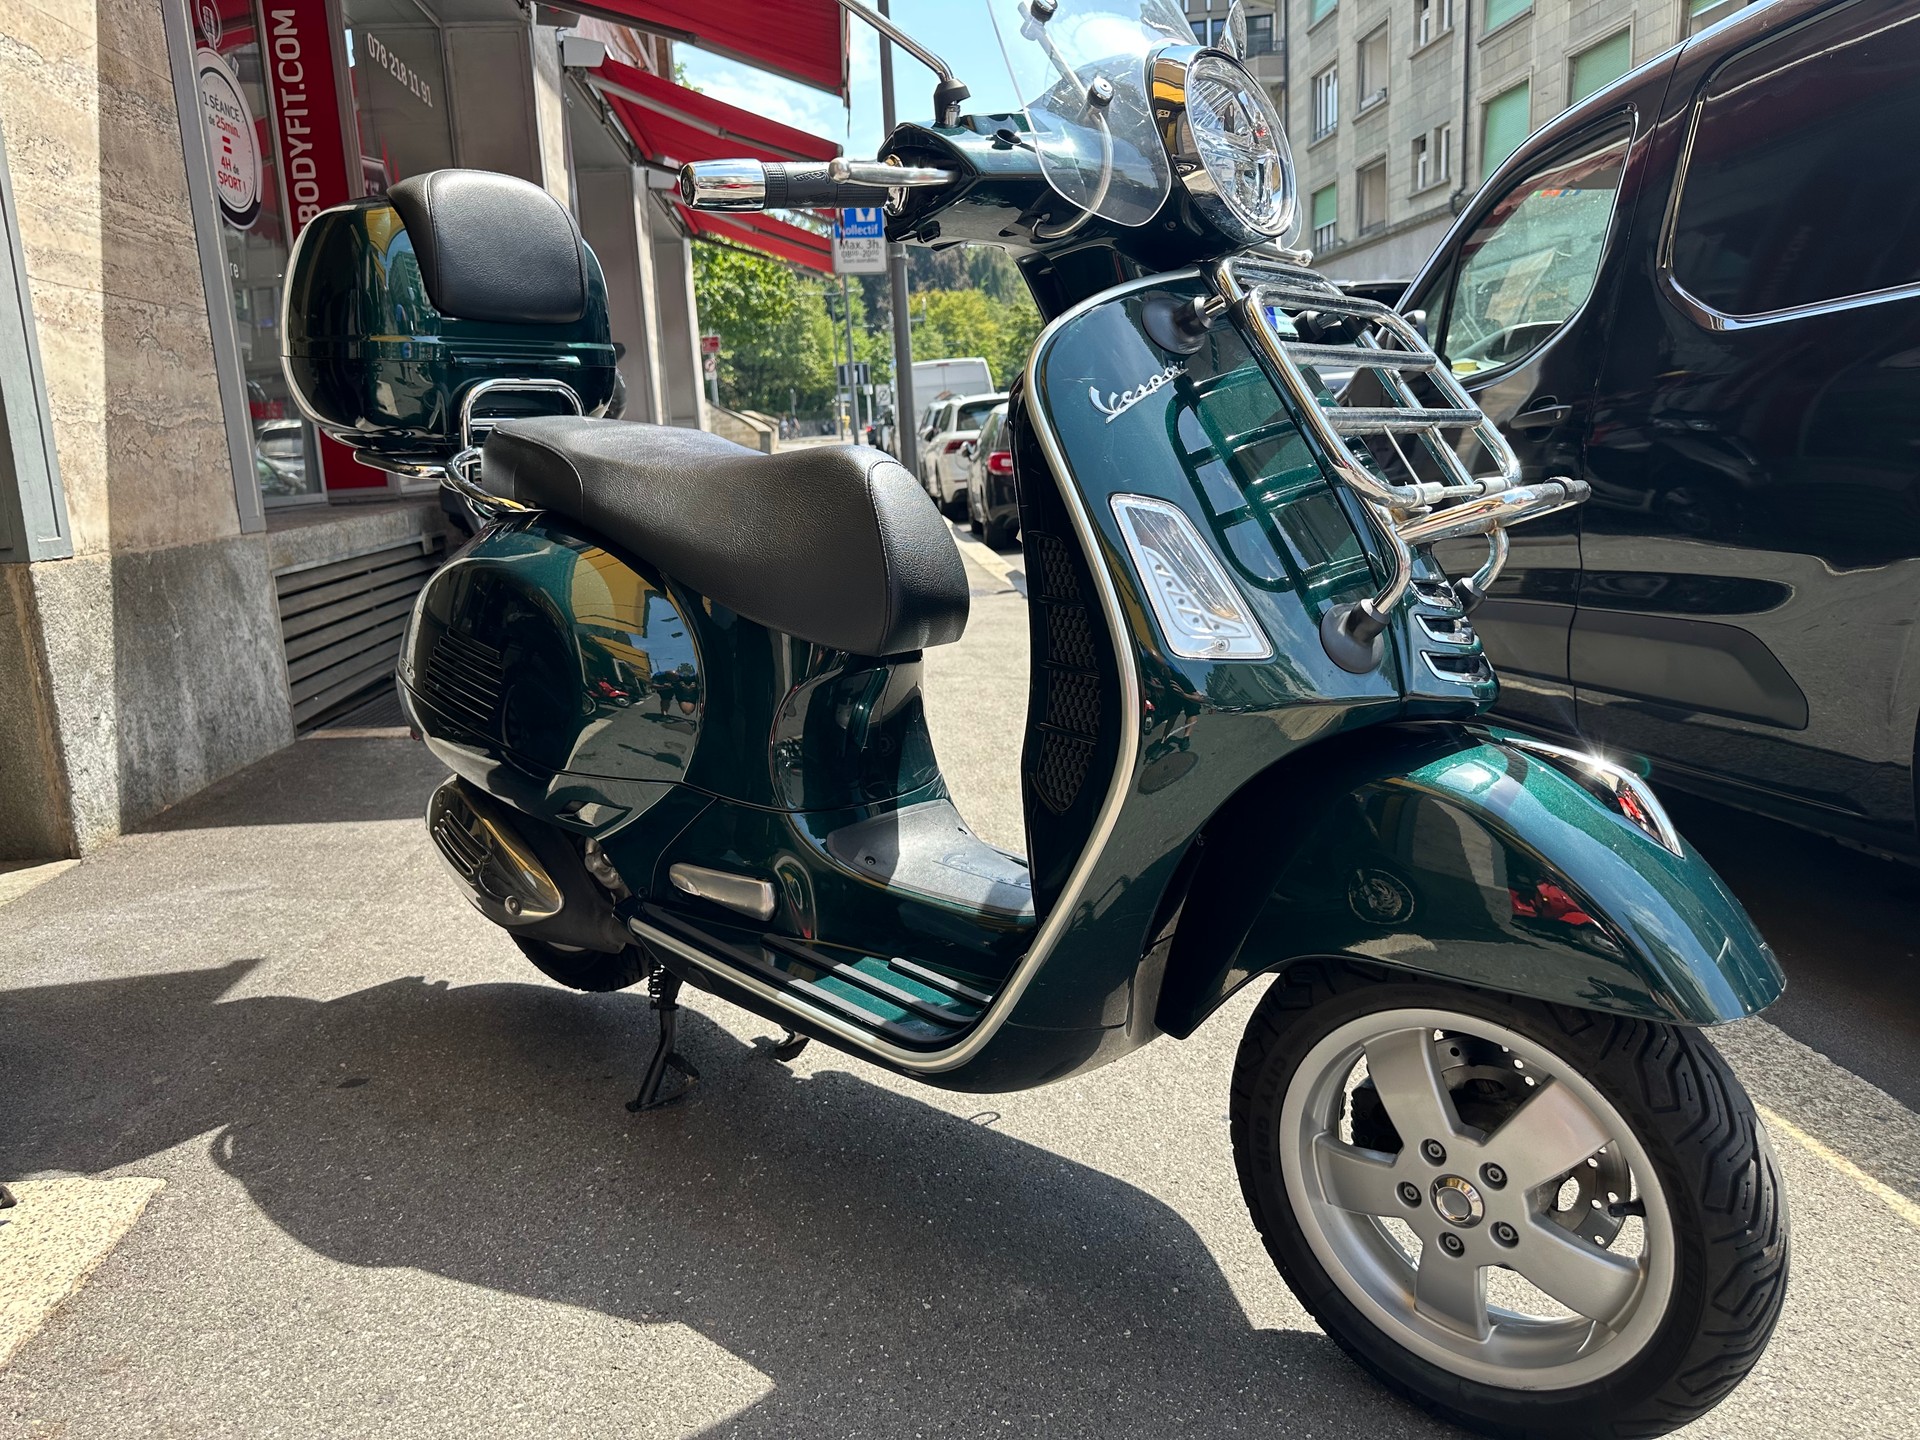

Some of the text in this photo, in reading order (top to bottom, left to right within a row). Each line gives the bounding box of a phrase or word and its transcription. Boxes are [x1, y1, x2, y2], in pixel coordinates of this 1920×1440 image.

[367, 32, 433, 107] 078 218 11 91
[203, 91, 240, 123] 1 SÉANCE
[271, 9, 322, 230] BODYFIT.COM
[215, 114, 241, 139] 25min.
[221, 156, 232, 172] 4H
[218, 170, 242, 193] SPORT
[1088, 366, 1189, 424] Vespa
